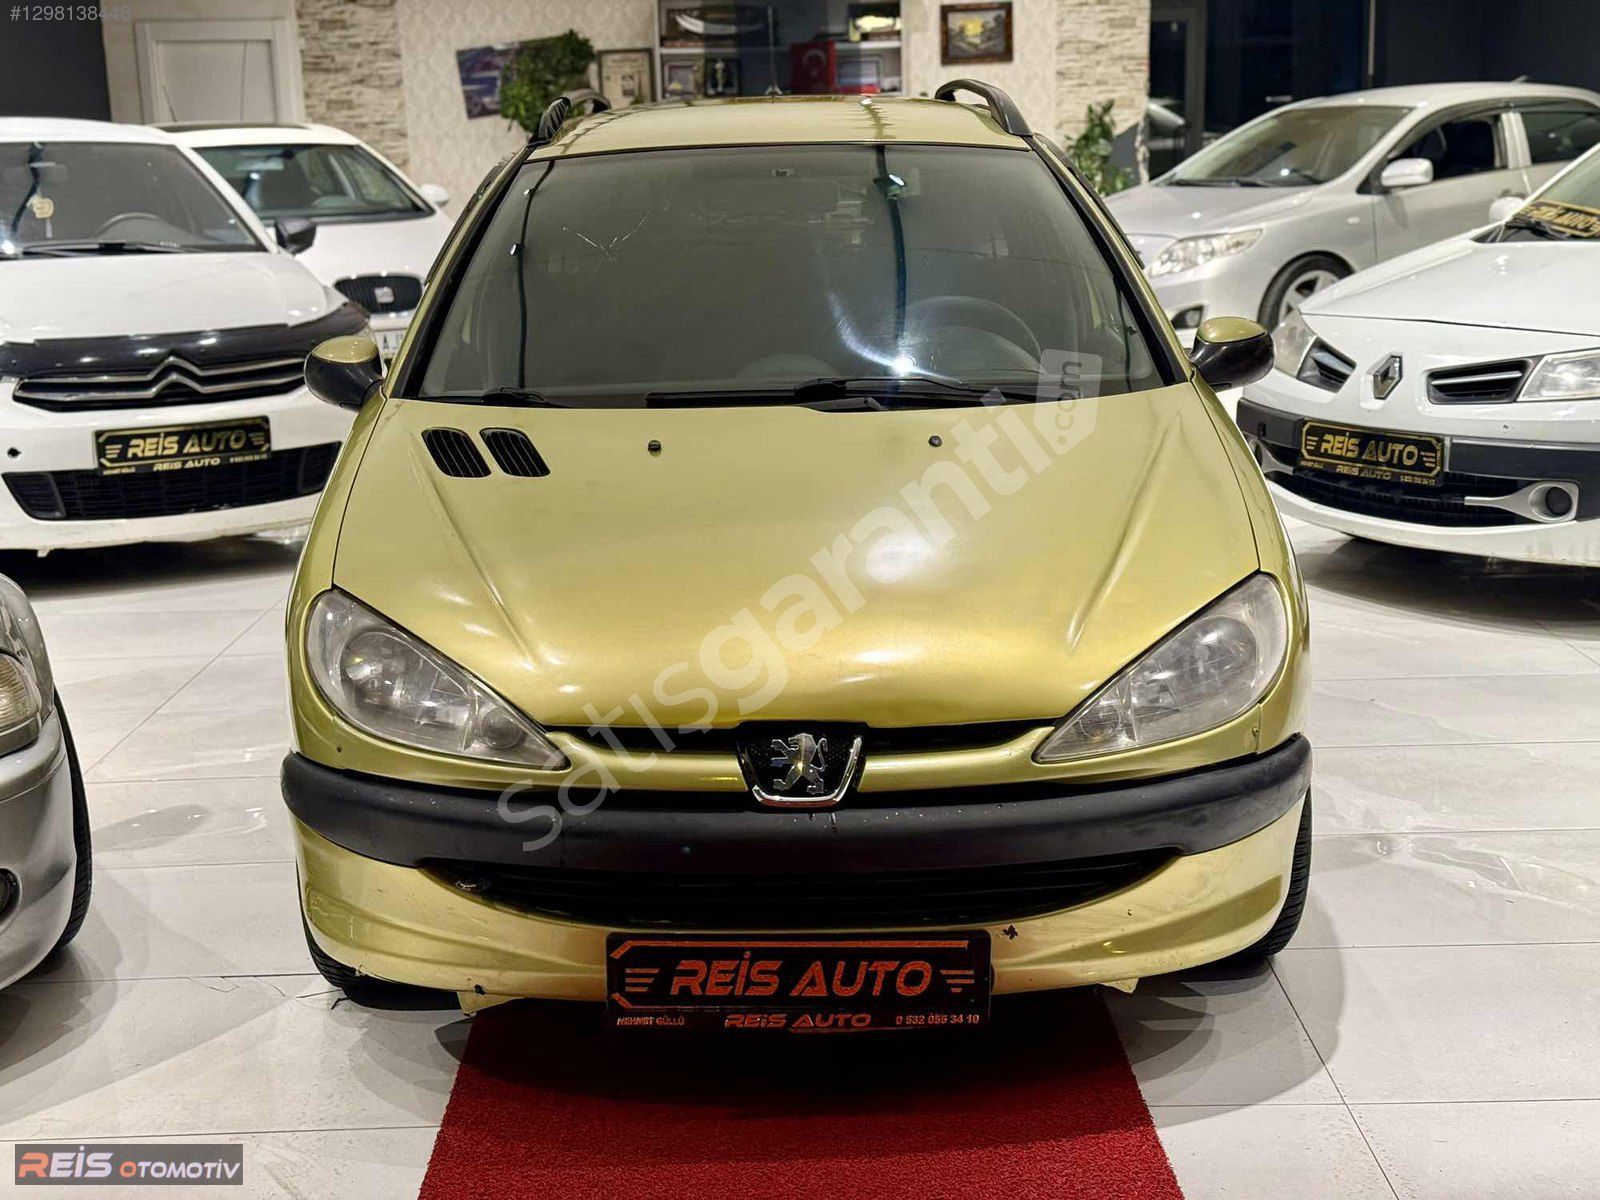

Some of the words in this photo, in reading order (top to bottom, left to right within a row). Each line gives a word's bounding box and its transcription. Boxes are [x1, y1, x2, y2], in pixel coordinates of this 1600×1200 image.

[183, 429, 246, 454] AUTO
[1362, 440, 1419, 466] AUTO
[184, 457, 221, 469] AUTO
[789, 959, 933, 996] AUTO
[792, 1013, 871, 1027] AUTO
[905, 1014, 926, 1025] 532
